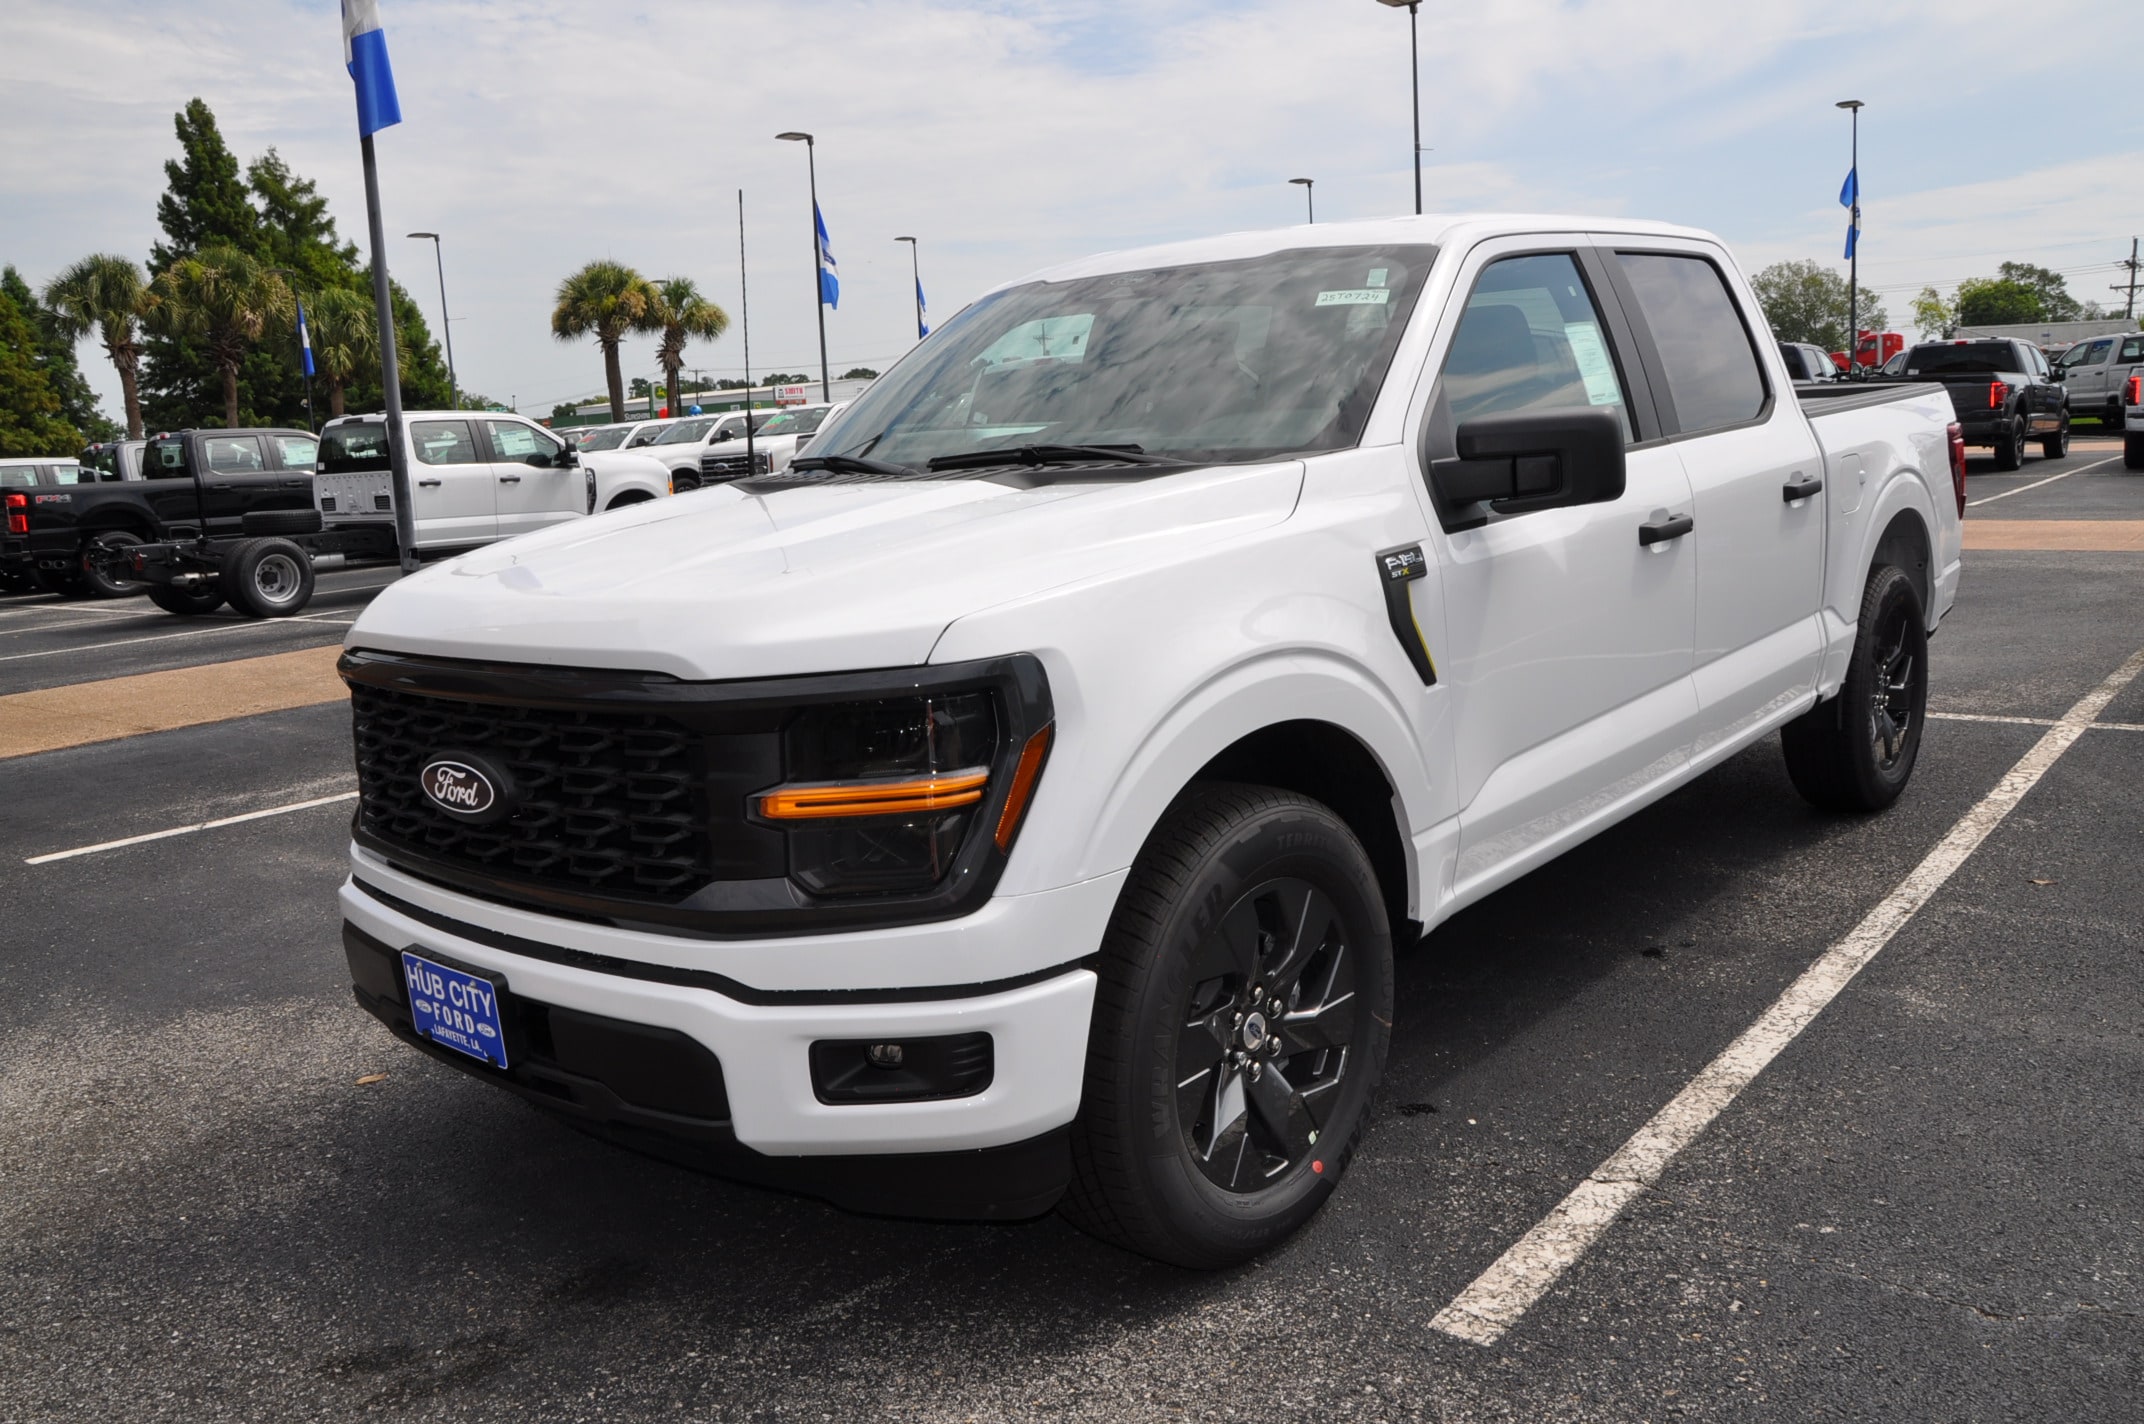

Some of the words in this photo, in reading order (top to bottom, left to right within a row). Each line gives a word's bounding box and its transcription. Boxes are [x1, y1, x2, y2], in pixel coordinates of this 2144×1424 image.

[35, 494, 72, 504] FX4
[1391, 567, 1411, 578] STX
[434, 766, 479, 806] Ford
[406, 964, 445, 1000] HUB
[448, 980, 491, 1018] CITY
[432, 1001, 475, 1034] FORD
